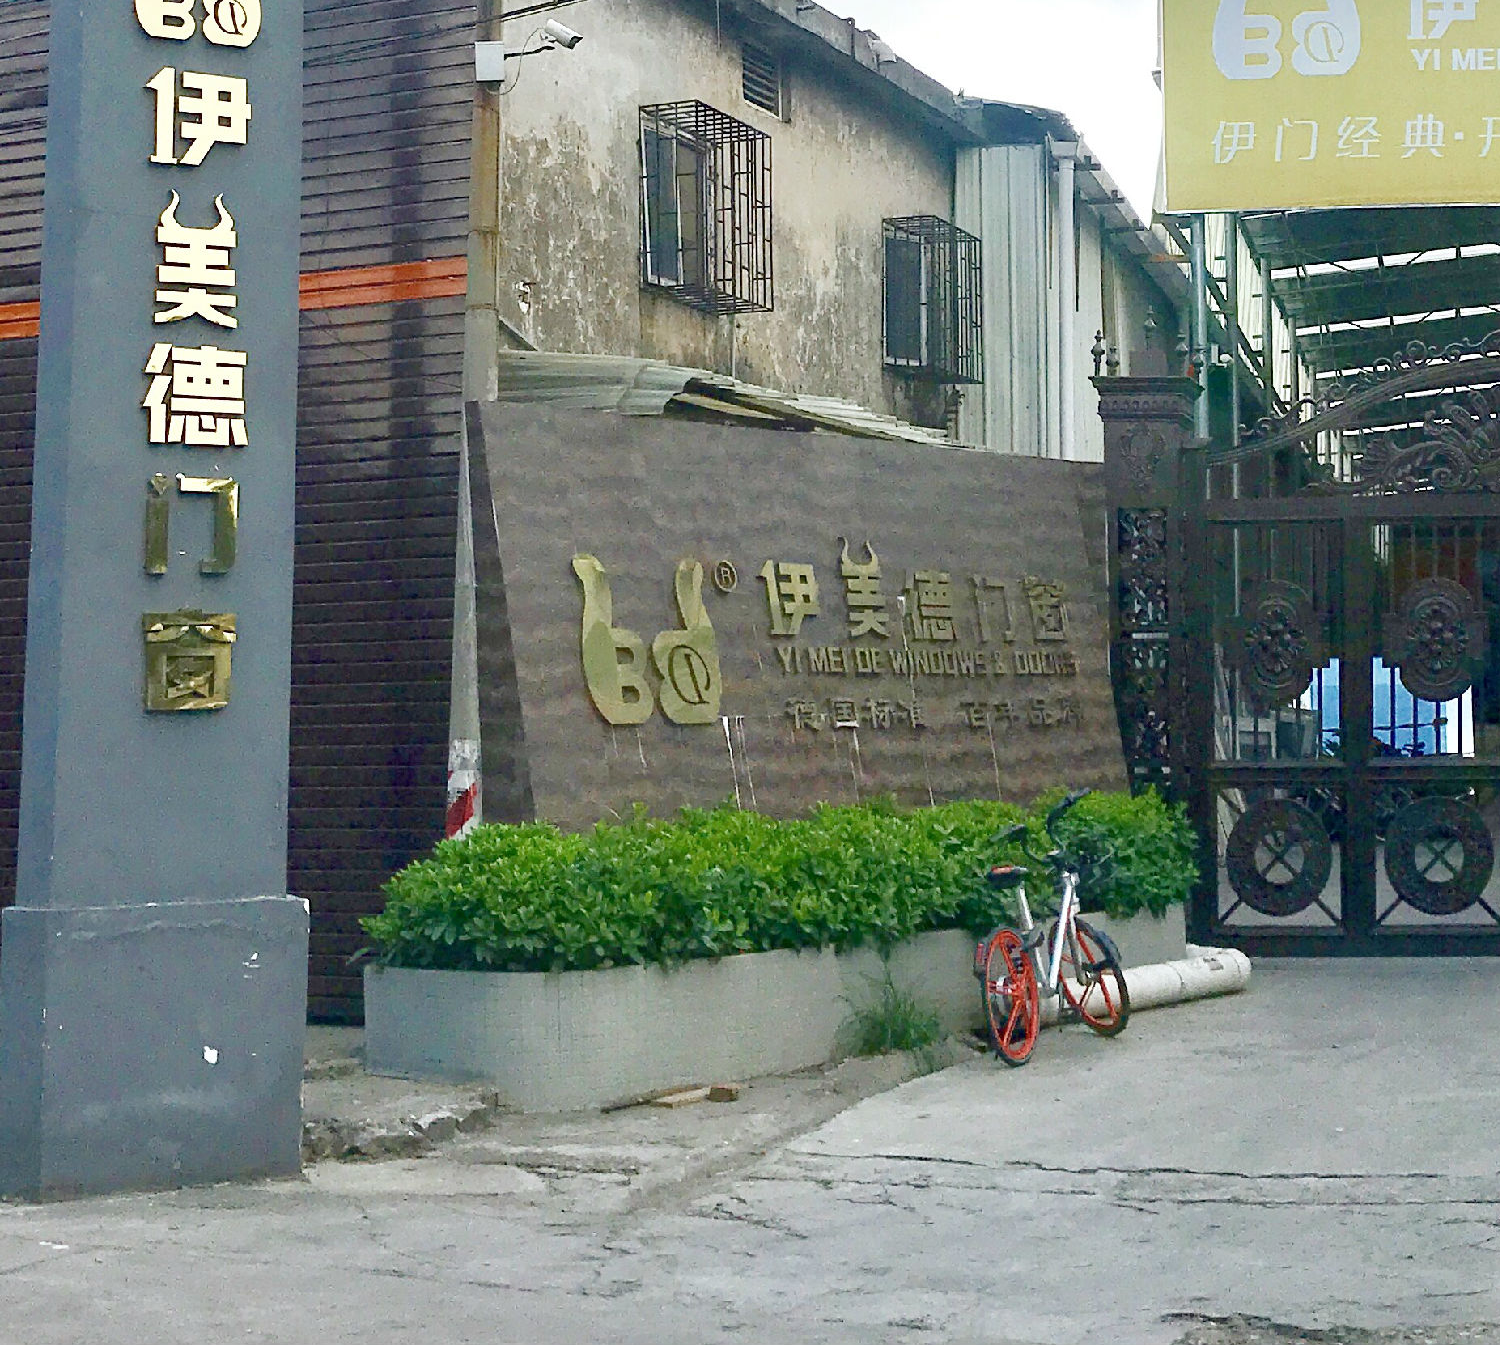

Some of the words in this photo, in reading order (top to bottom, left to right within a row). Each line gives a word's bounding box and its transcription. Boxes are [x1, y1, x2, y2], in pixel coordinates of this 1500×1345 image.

[1411, 47, 1441, 71] YI
[141, 65, 253, 711] 伊美德门窗
[760, 536, 1070, 643] 伊美德门窗
[777, 647, 802, 673] YI
[808, 647, 849, 674] MEI
[854, 647, 882, 674] DE
[889, 649, 986, 677] WINDOWS
